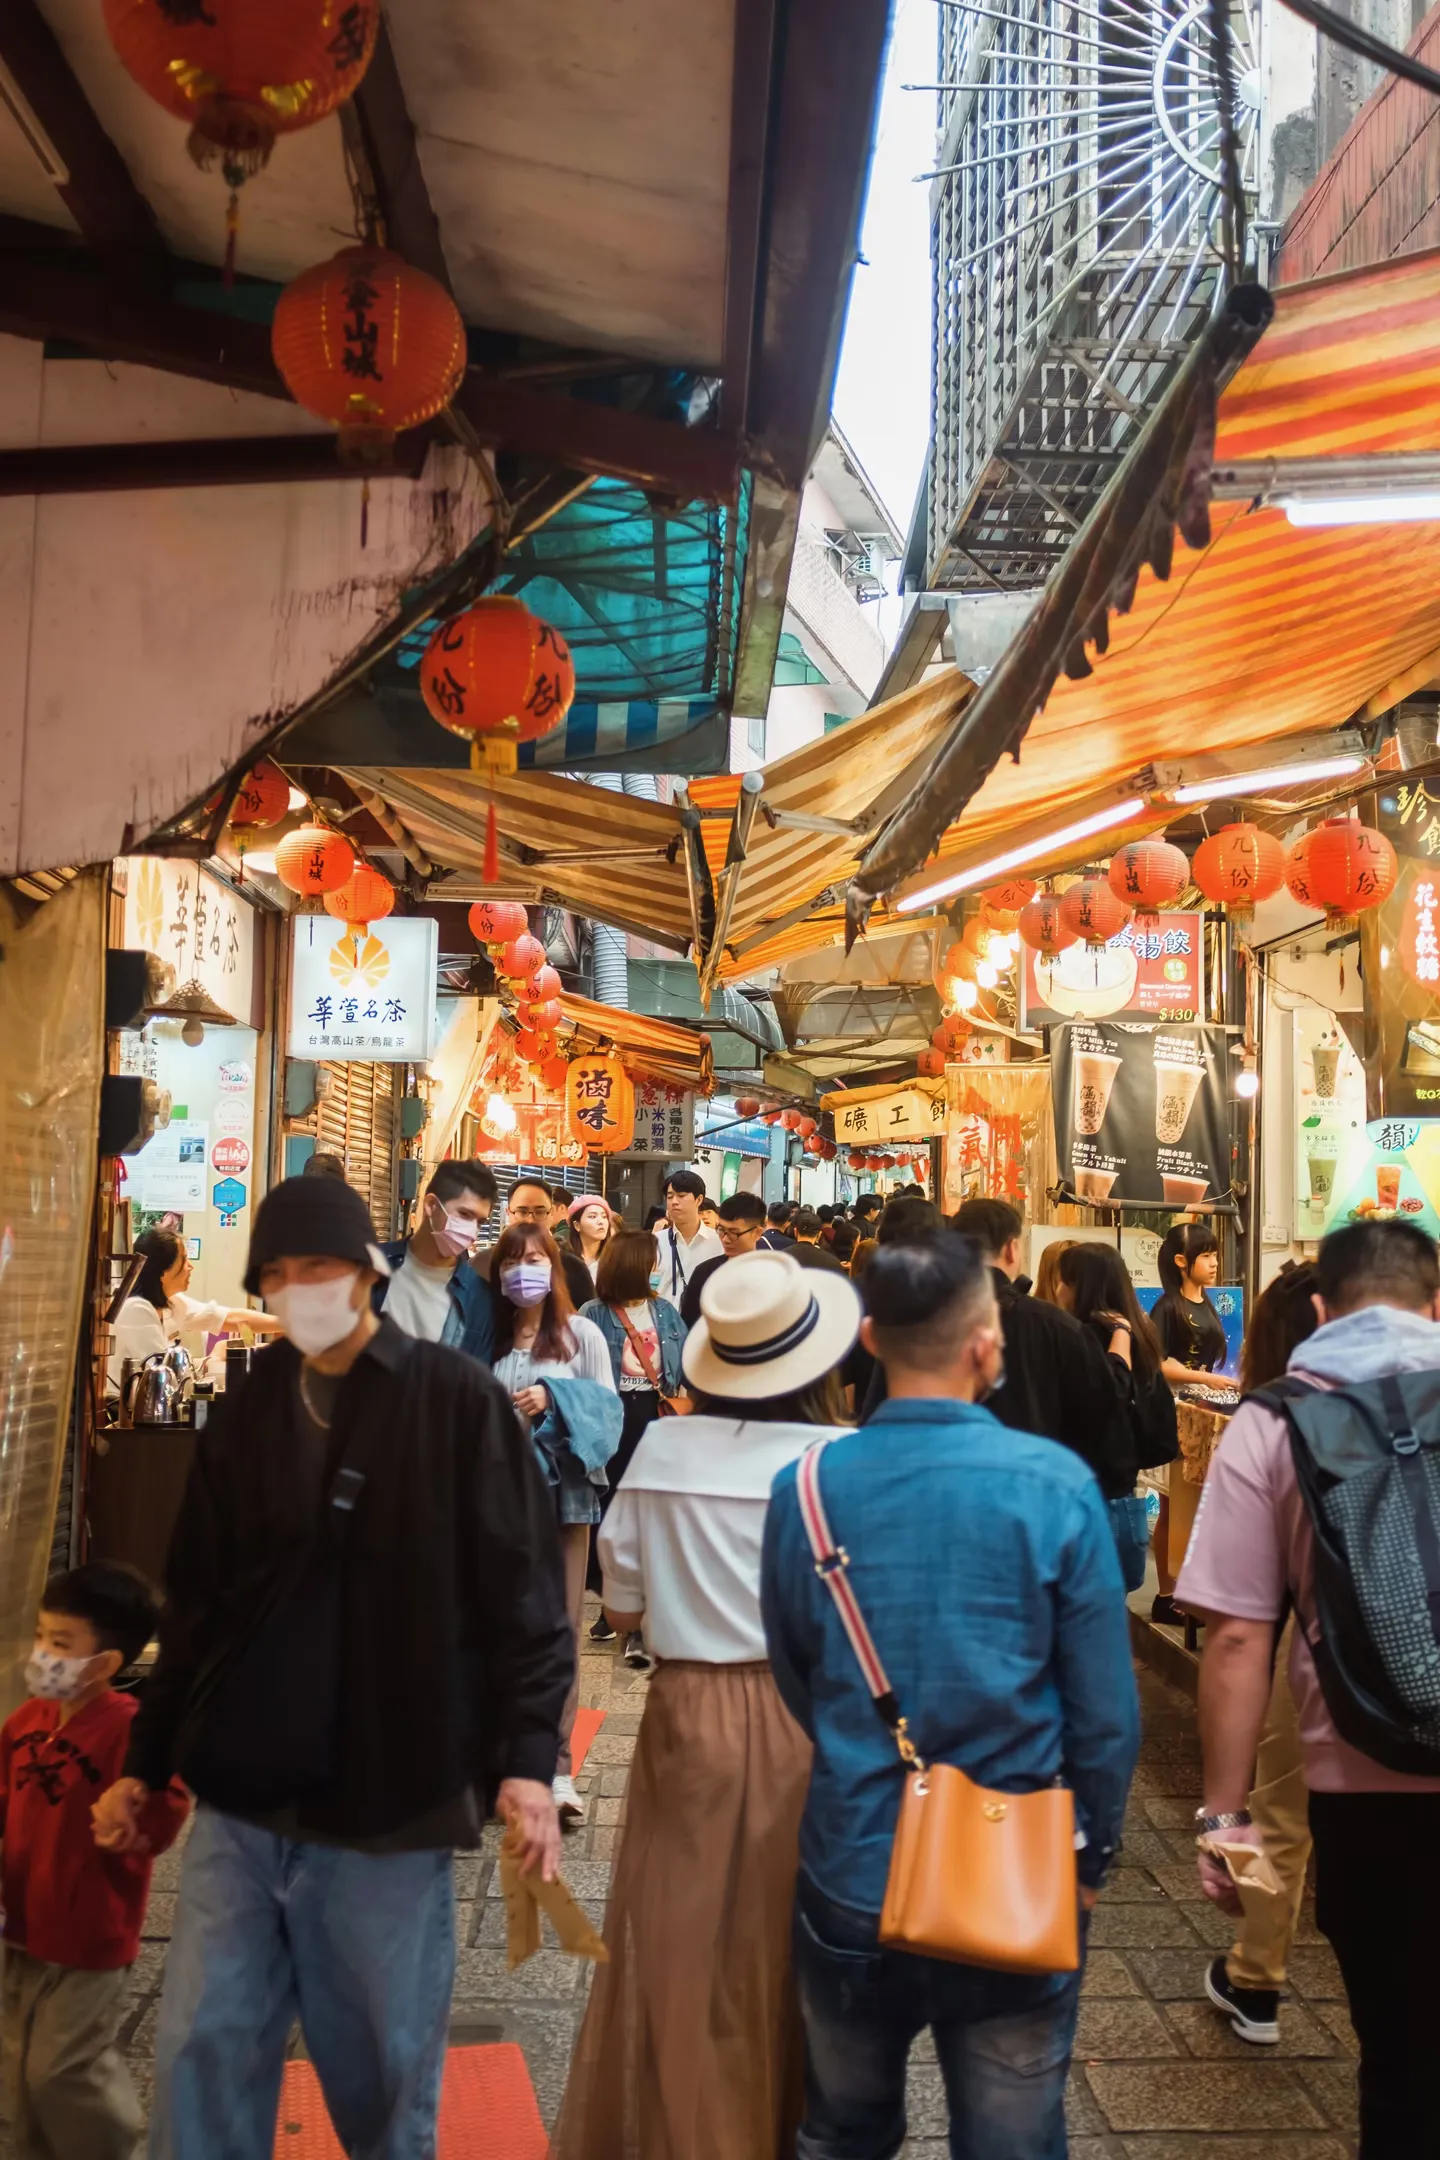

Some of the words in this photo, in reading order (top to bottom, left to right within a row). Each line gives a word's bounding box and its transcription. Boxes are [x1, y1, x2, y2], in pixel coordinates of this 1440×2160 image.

[429, 616, 467, 715] 九份
[525, 624, 569, 717] 九份
[1230, 836, 1254, 889] 九份
[1356, 834, 1381, 896] 九份
[1414, 882, 1440, 981] 花生軟糖
[307, 995, 407, 1030] 華萱名茶
[1159, 1007, 1193, 1021] $130
[1070, 1034, 1087, 1042] Pearl
[1088, 1037, 1104, 1045] Milk
[575, 1068, 617, 1131] 滷味
[634, 1108, 649, 1152] 小菜
[651, 1108, 666, 1152] 米粉湯
[669, 1107, 683, 1153] 各種丸仔湯
[1375, 1123, 1406, 1151] 韻
[1157, 1156, 1175, 1164] Fruit
[1175, 1159, 1195, 1167] Black
[1196, 1162, 1209, 1170] Tea
